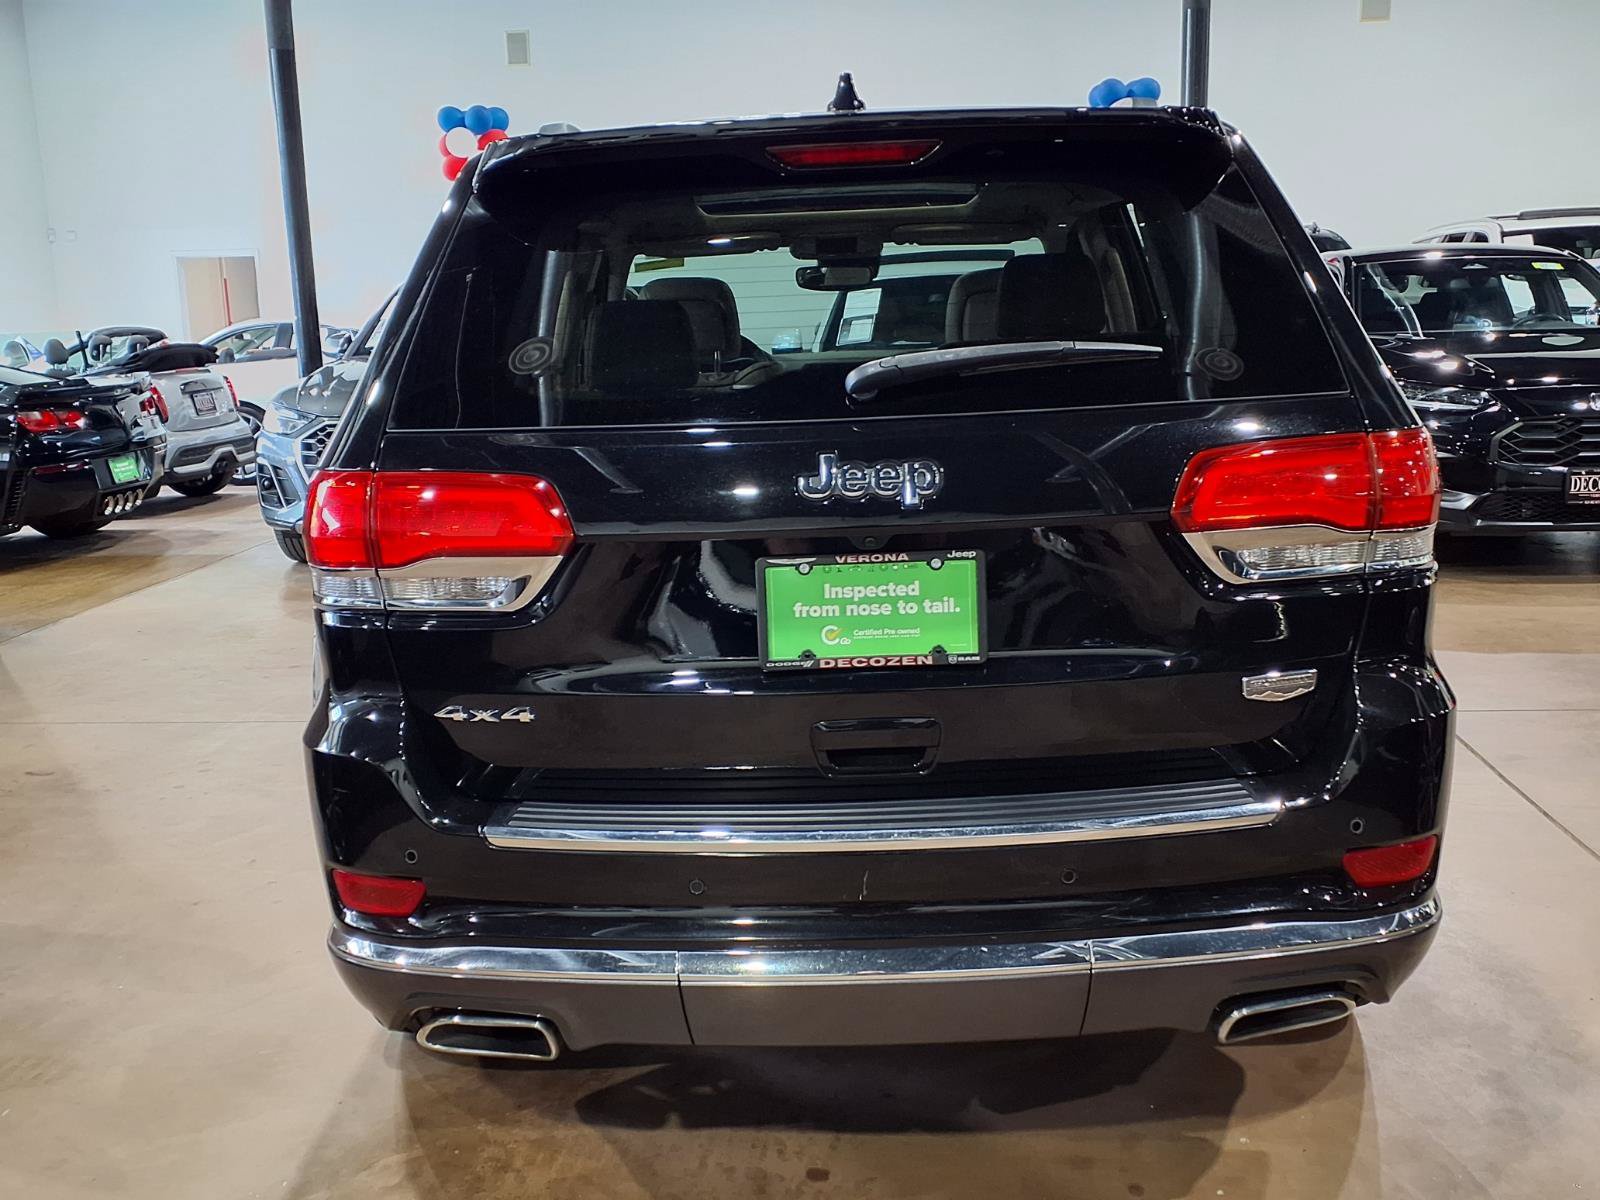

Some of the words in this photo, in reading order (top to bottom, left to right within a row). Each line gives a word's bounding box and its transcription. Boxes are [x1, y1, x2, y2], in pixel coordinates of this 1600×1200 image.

[797, 452, 943, 509] Jeep
[1570, 475, 1600, 492] DEC
[835, 552, 909, 564] VERONA
[947, 550, 977, 558] Jeep
[823, 581, 920, 601] Inspected
[793, 602, 840, 617] from
[846, 602, 892, 616] nose
[897, 600, 919, 615] to
[923, 597, 961, 613] tail.
[819, 655, 933, 668] DECOZEN
